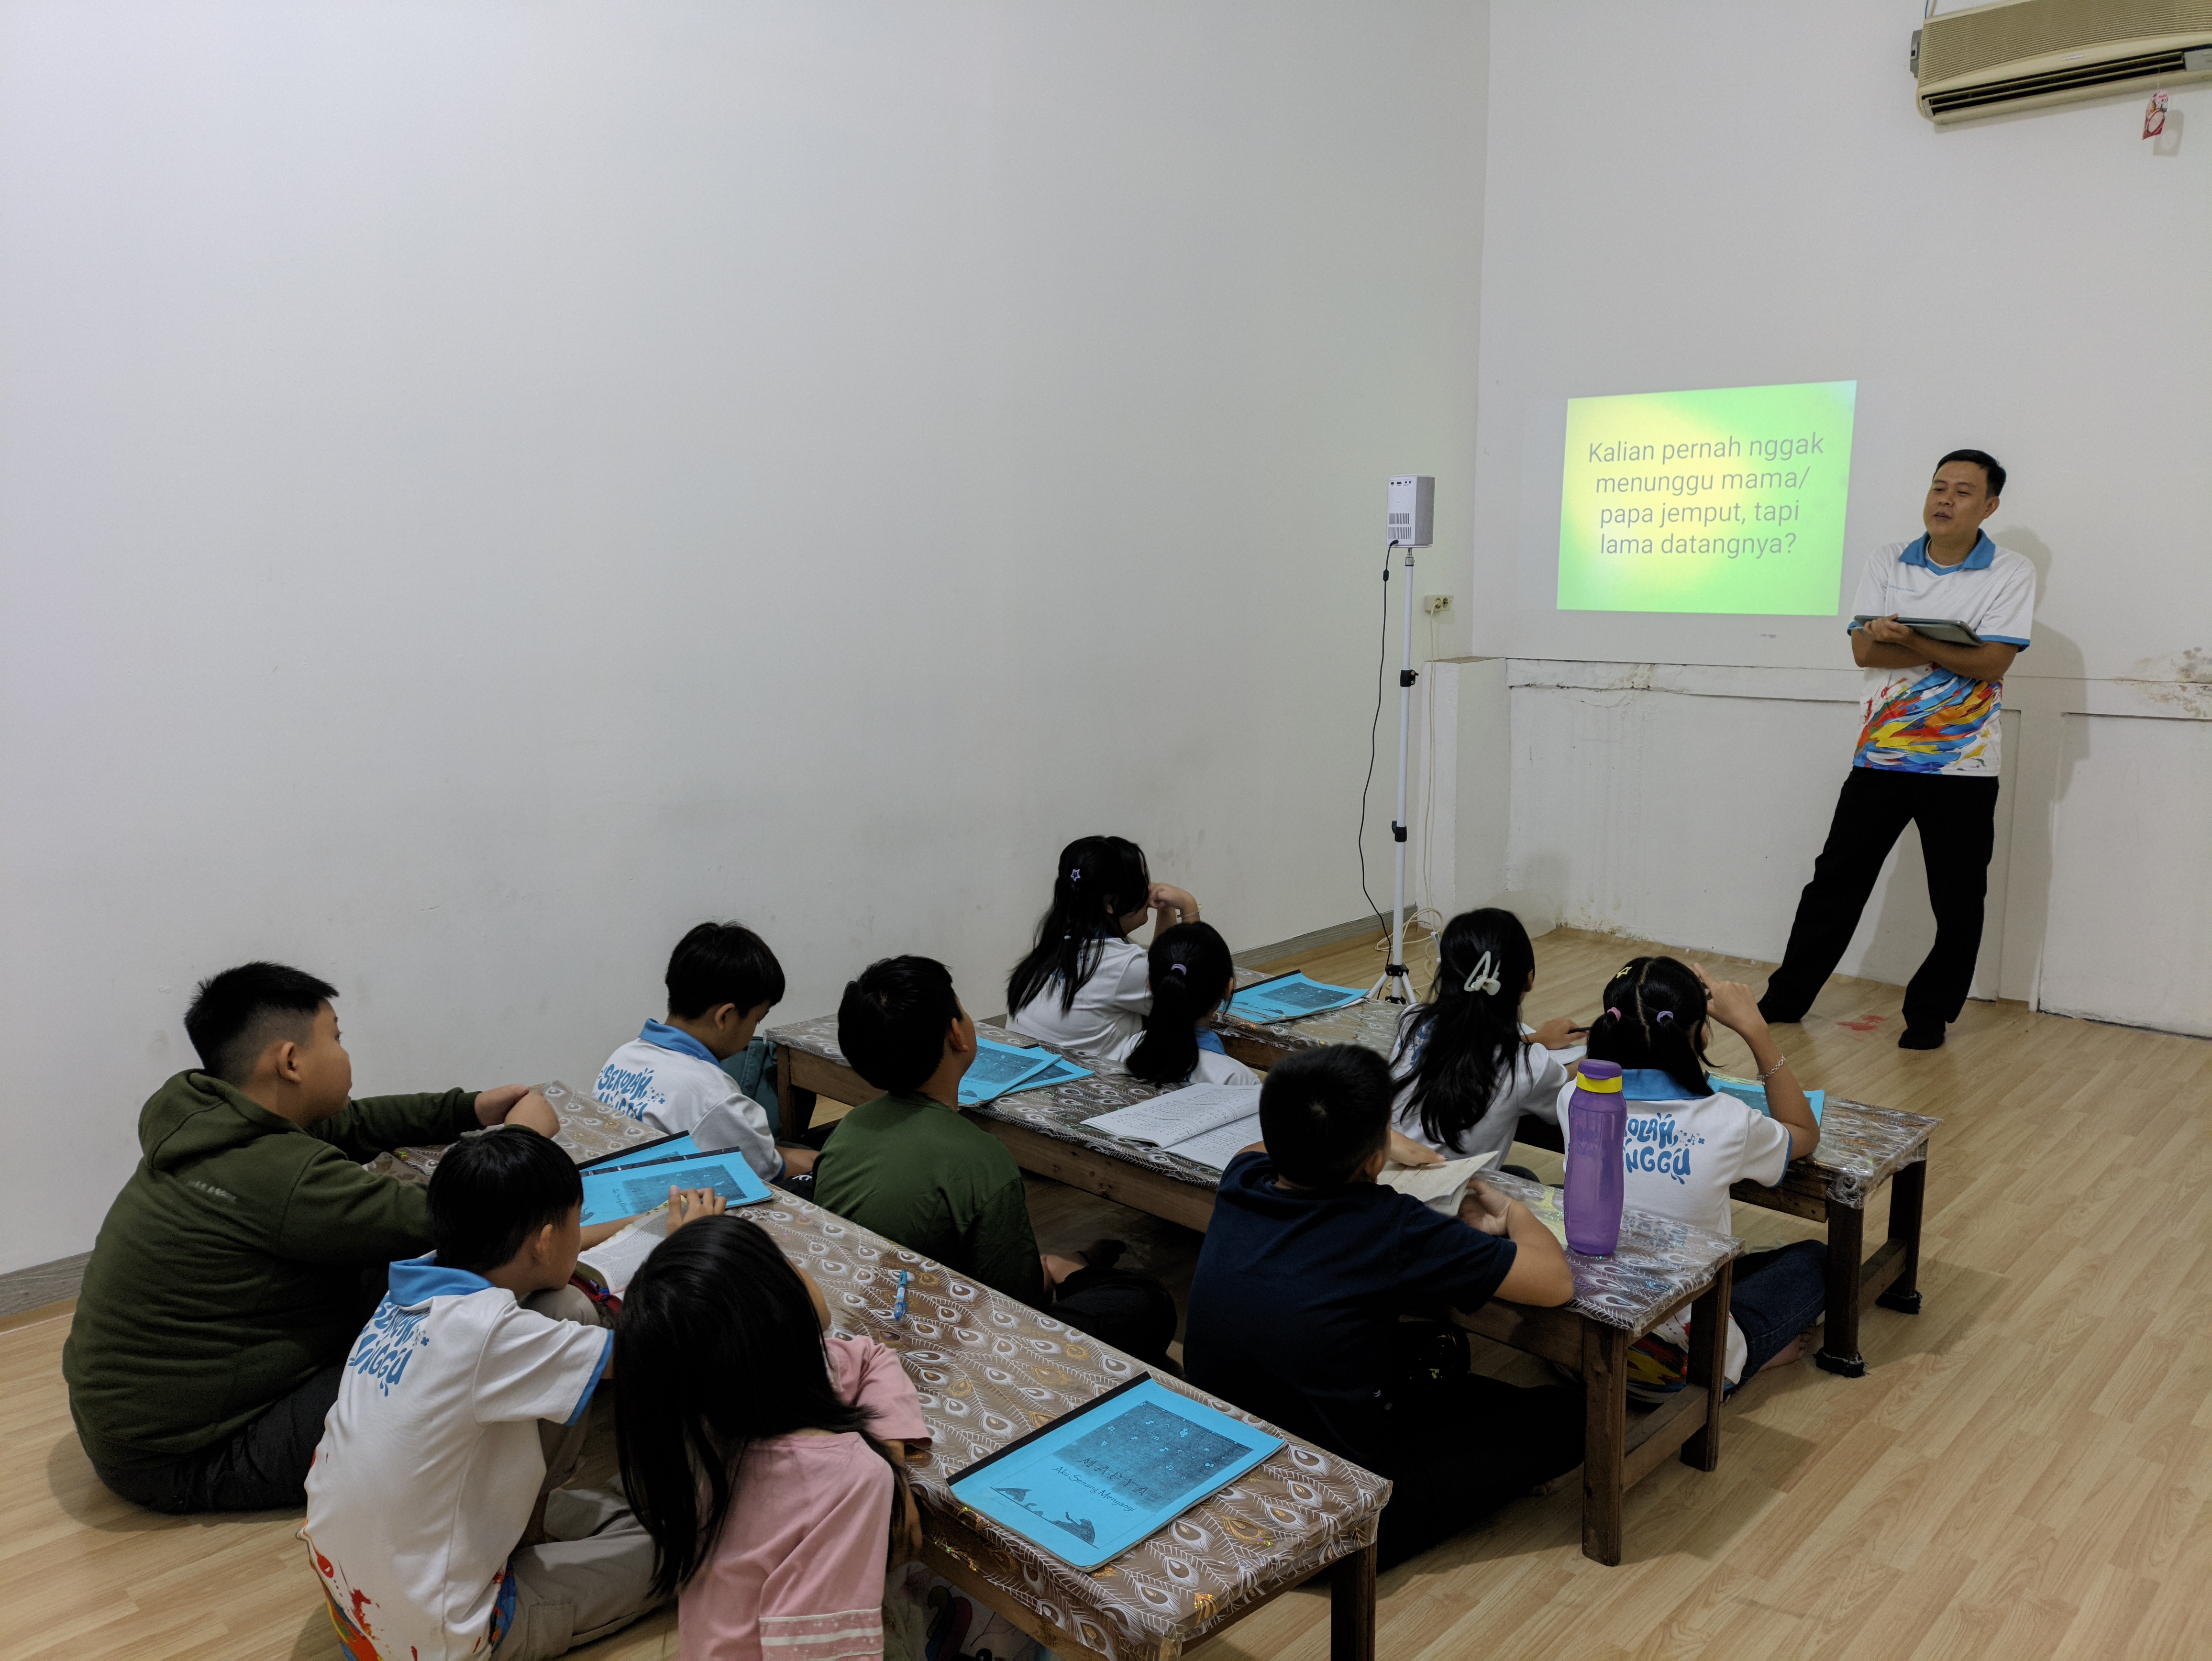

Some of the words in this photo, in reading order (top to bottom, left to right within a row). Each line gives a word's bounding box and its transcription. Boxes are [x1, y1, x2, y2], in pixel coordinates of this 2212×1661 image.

[1588, 441, 1654, 463] Kalian
[1662, 436, 1741, 465] pernah
[1749, 432, 1825, 461] nggak
[1596, 473, 1714, 496] menunggu
[1722, 466, 1811, 489] mama/
[1600, 505, 1653, 529] papa
[1659, 502, 1746, 528] jemput,
[1754, 500, 1800, 526] tapi
[1600, 533, 1653, 554] lama
[1661, 532, 1796, 559] datangnya?
[598, 1063, 653, 1100] SEKOLAH
[1622, 1146, 1691, 1176] NGGU
[1051, 1467, 1070, 1477] Aku
[1068, 1474, 1100, 1494] Senang
[1097, 1489, 1138, 1512] Menyanyi
[1076, 1457, 1148, 1496] MADYA
